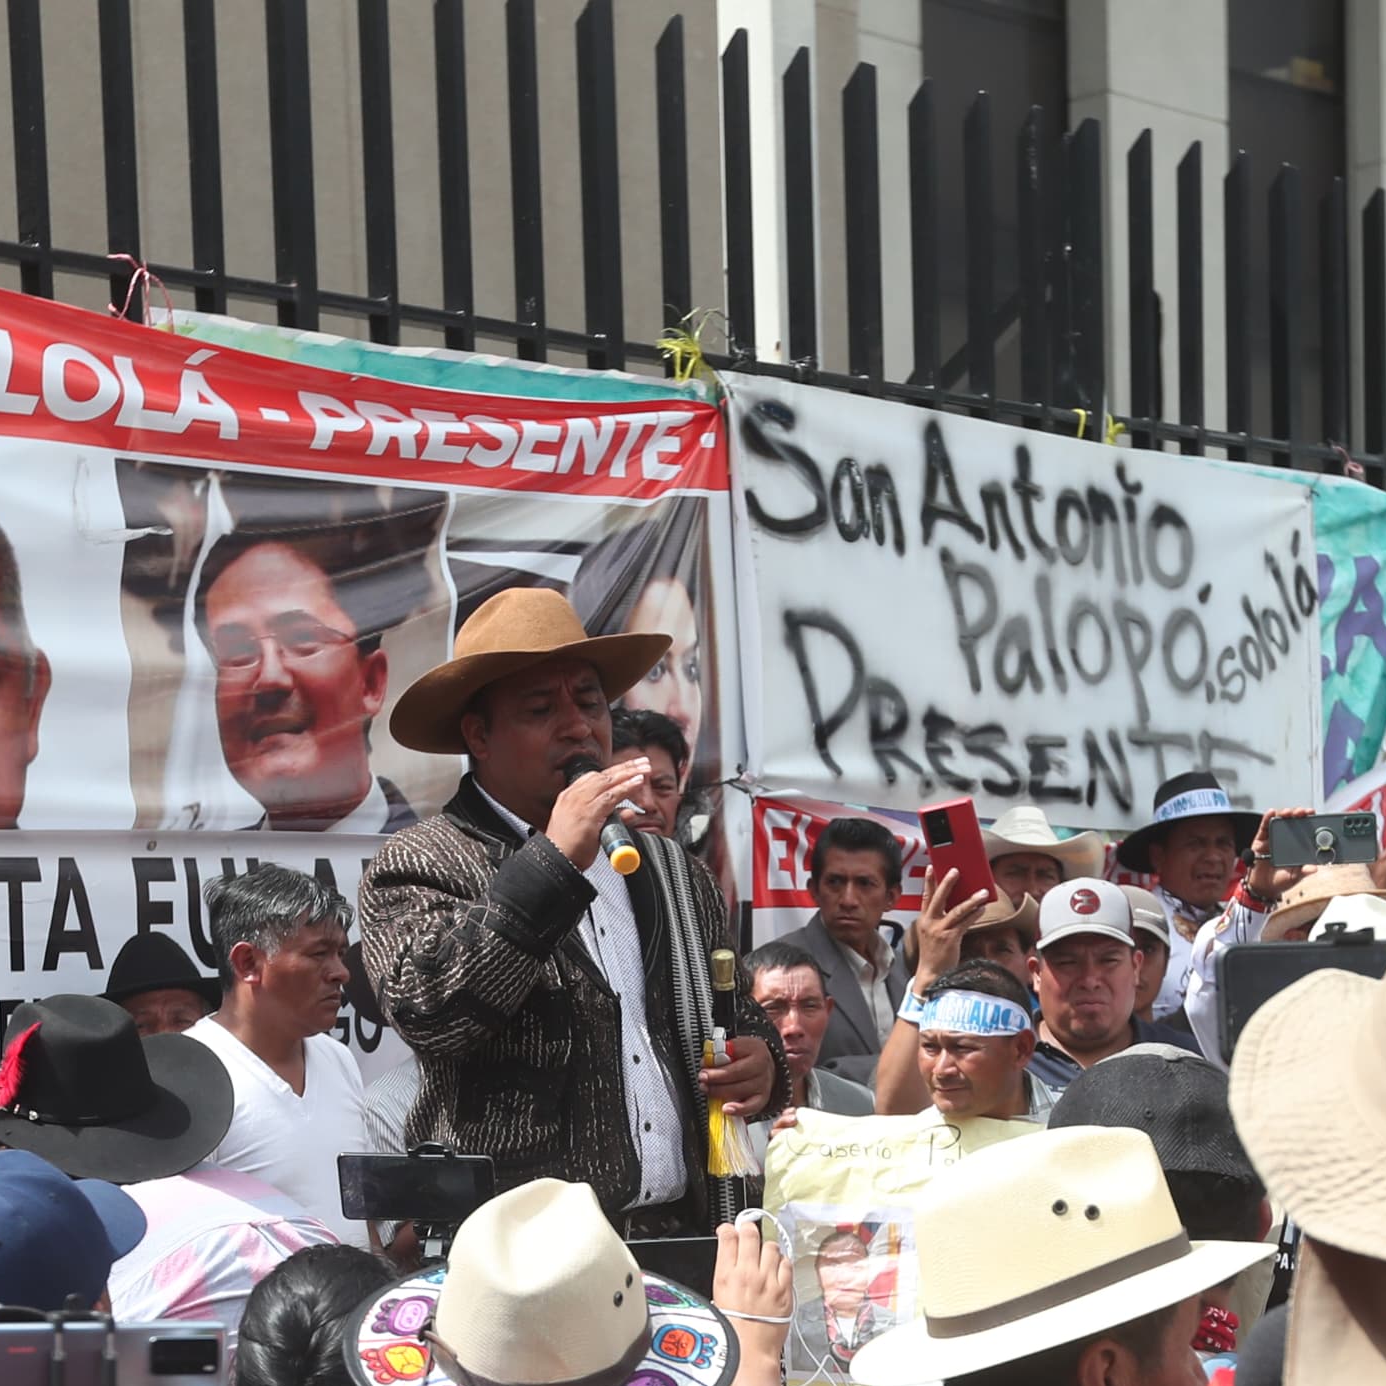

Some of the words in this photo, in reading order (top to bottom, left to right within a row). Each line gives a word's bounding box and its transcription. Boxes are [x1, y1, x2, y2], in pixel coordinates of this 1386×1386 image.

[296, 391, 695, 482] PRESENTE
[741, 400, 906, 556] San
[921, 418, 1195, 590] Antonio
[782, 607, 1275, 812] PRESENTE
